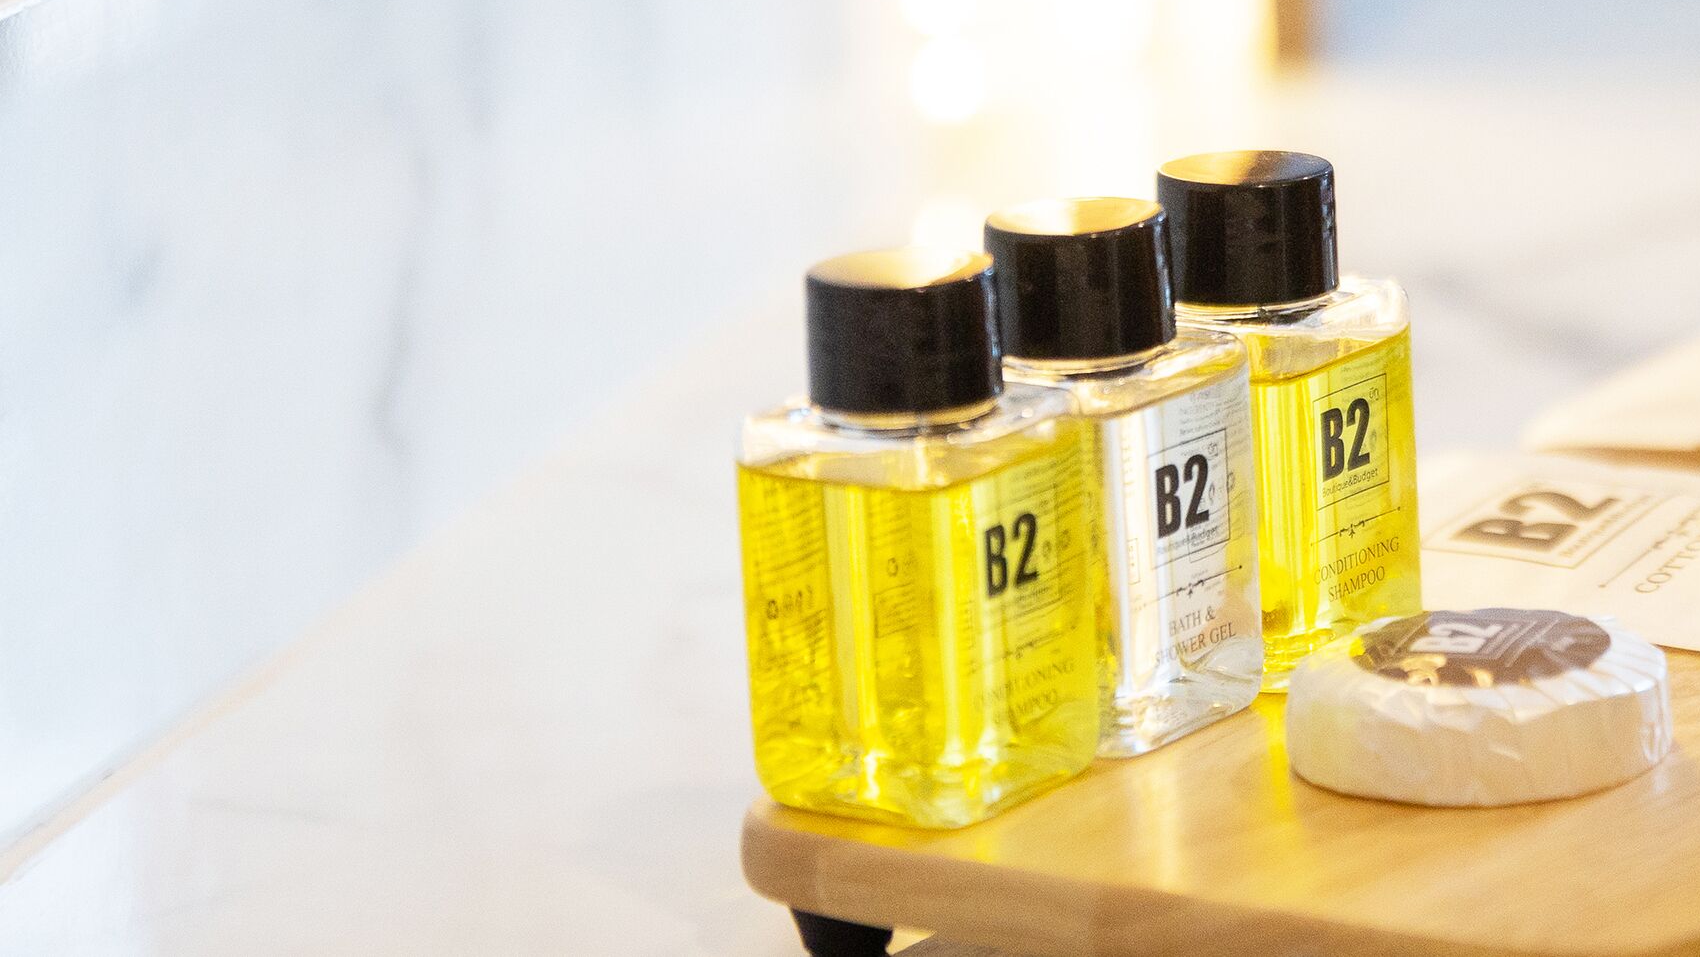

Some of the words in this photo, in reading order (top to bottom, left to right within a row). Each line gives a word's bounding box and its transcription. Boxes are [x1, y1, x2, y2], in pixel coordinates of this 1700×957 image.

[1320, 397, 1370, 482] B2
[1155, 453, 1210, 539] B2
[1451, 491, 1621, 552] B2
[984, 512, 1039, 598] B2
[1313, 536, 1400, 586] CONDITIONING
[1327, 565, 1386, 602] SHAMPOO
[1155, 633, 1207, 665] SHOWER
[1209, 621, 1237, 644] GEL
[1169, 610, 1202, 638] BATH
[1204, 605, 1216, 622] &
[1407, 622, 1504, 654] B2
